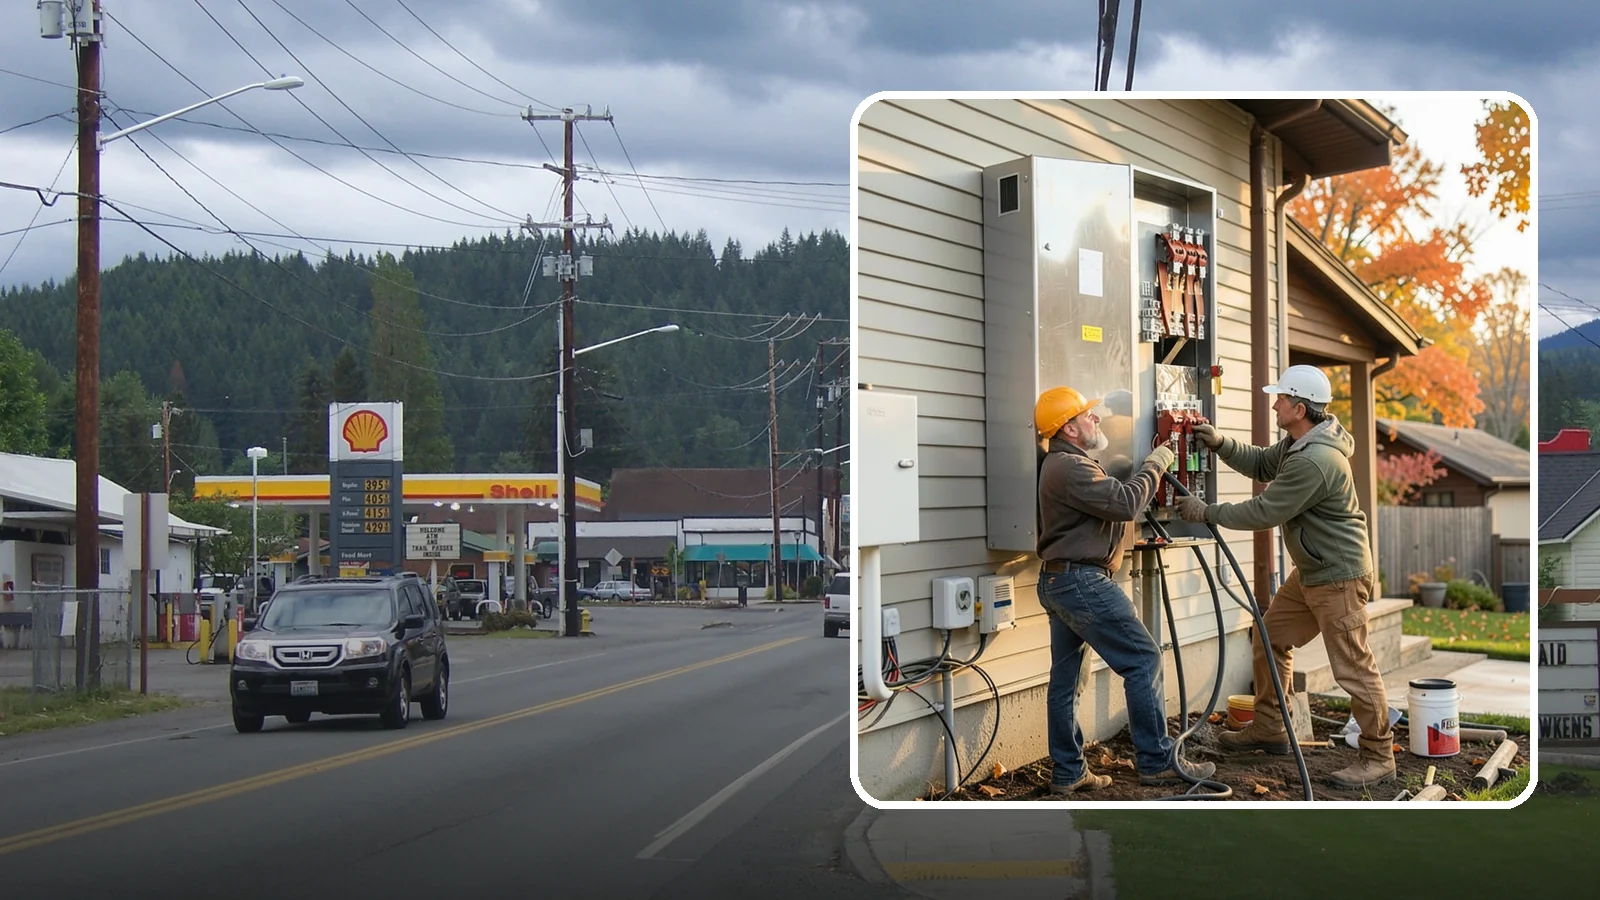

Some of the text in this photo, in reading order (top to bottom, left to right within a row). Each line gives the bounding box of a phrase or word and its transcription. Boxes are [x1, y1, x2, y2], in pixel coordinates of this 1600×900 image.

[365, 480, 384, 490] 395
[490, 484, 547, 499] Shell
[365, 494, 384, 504] 405
[365, 508, 383, 518] 415
[365, 522, 384, 533] 429
